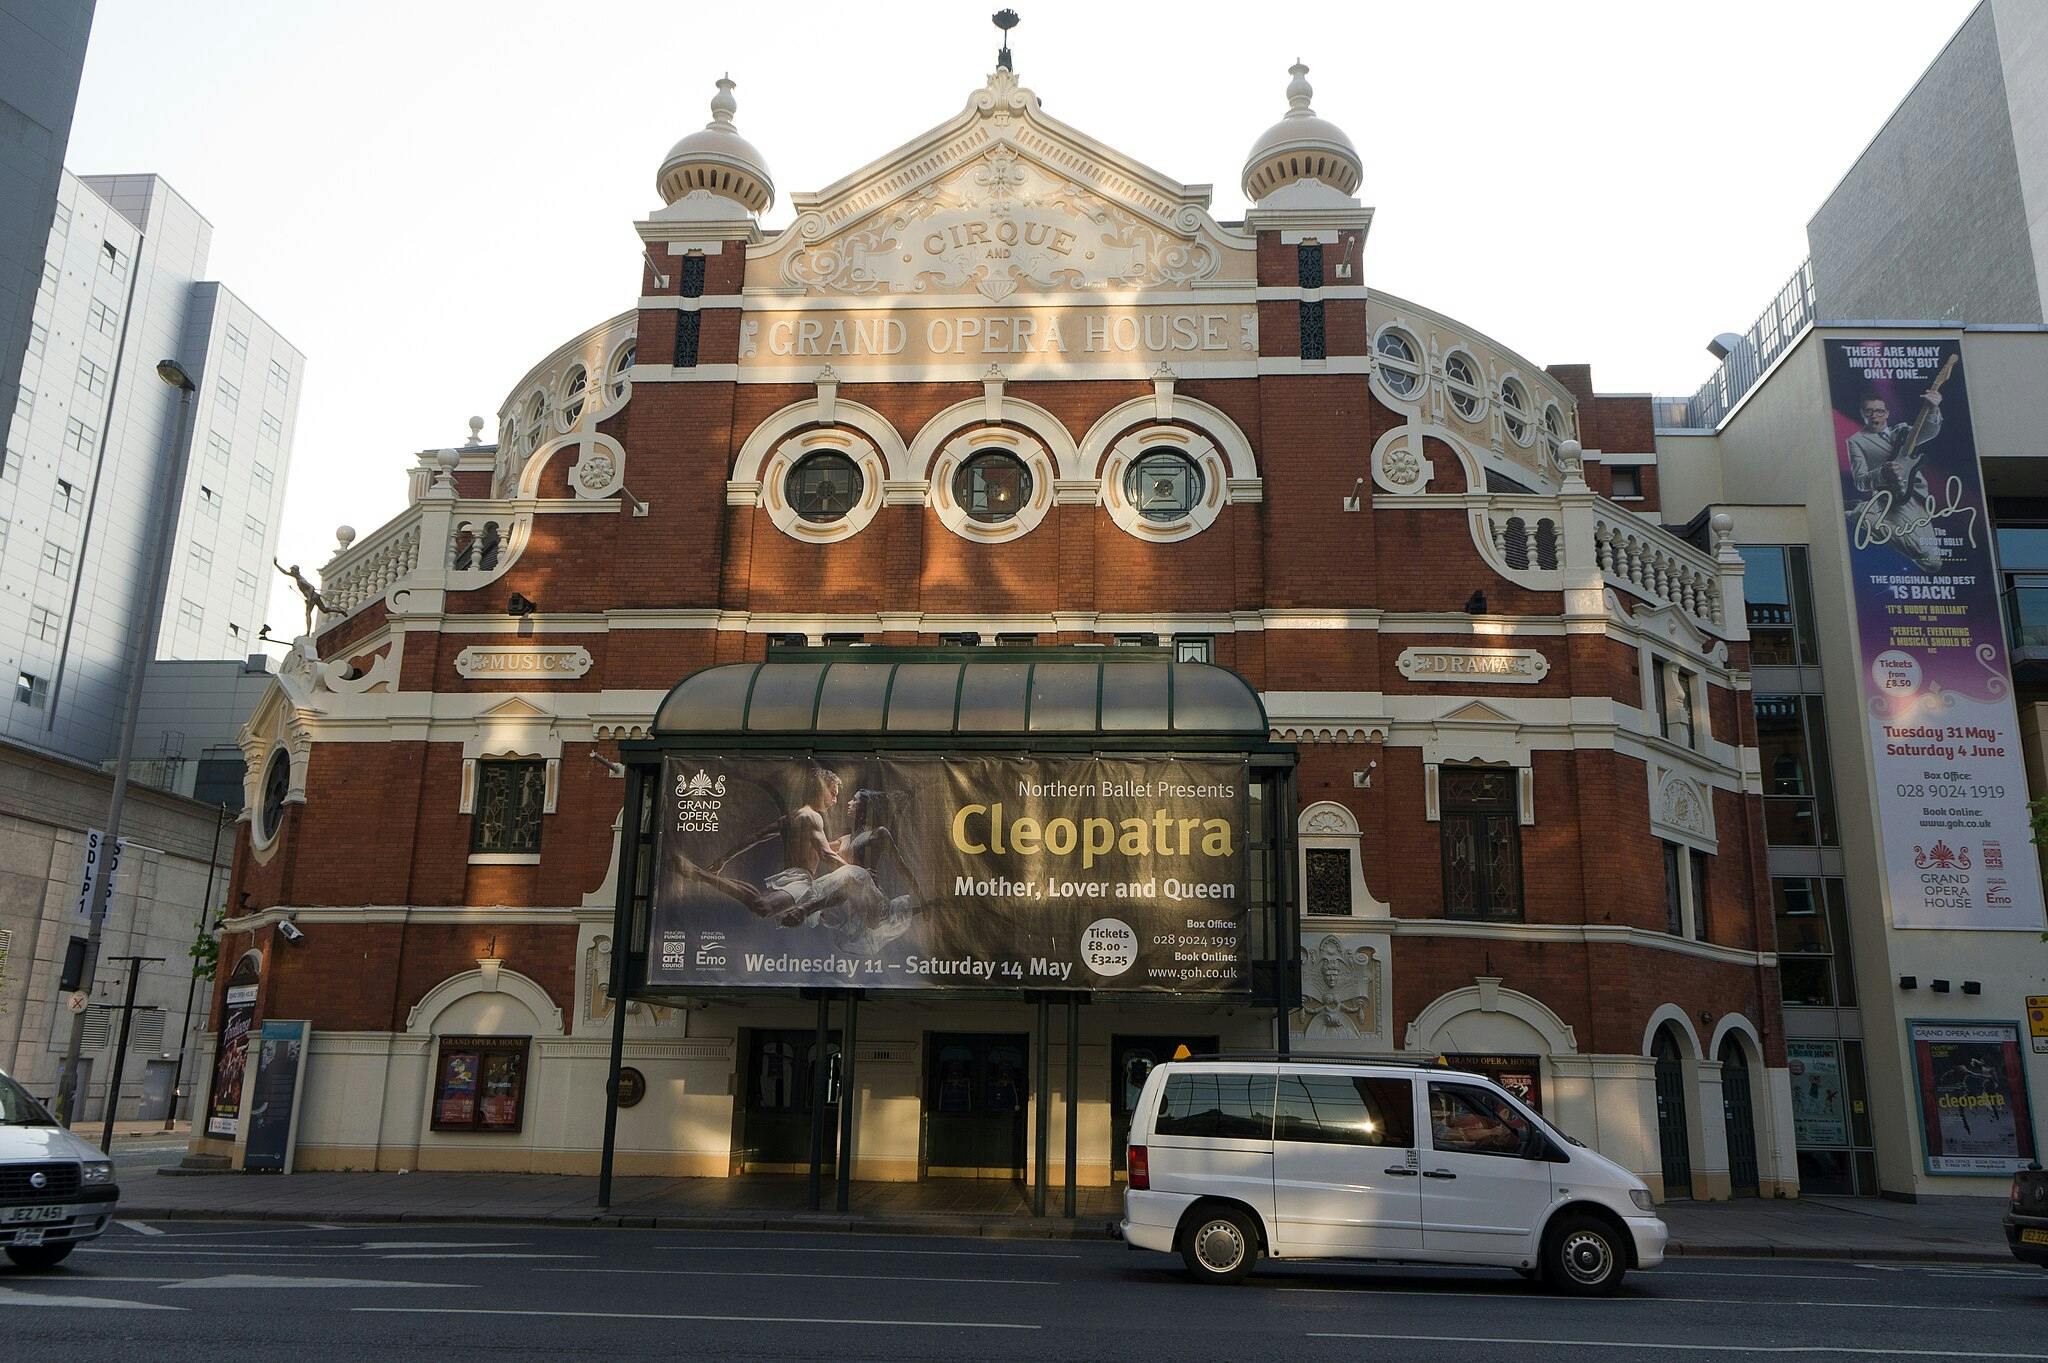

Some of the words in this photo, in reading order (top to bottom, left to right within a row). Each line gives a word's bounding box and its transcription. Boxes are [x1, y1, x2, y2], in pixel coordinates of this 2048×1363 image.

[923, 219, 1078, 256] CIRQUE
[985, 248, 1011, 259] AND
[768, 318, 907, 356] GRAND
[926, 316, 1065, 355] OPERA
[1084, 312, 1231, 353] HOUSE
[1883, 347, 1906, 357] ARE
[1906, 347, 1940, 357] MANY
[1849, 357, 1915, 369] IMITATIONS
[1916, 358, 1940, 368] BUT
[1863, 368, 1893, 379] ONLY
[1934, 527, 1947, 537] The
[1943, 538, 1964, 547] HOLLY
[1870, 575, 1888, 585] THE
[1889, 576, 1931, 585] ORIGINAL
[1932, 576, 1951, 585] AND
[1952, 576, 1976, 585] BEST
[1911, 586, 1956, 600] BACK!
[489, 654, 557, 671] MUSIC
[1433, 655, 1513, 674] DRAMA
[1879, 659, 1913, 669] Tickets
[1888, 670, 1906, 679] from
[1883, 725, 1944, 743] Tuesday
[1946, 726, 1964, 739] 31
[1966, 726, 1996, 743] May
[1886, 743, 1955, 761] Saturday
[1957, 745, 1968, 757] 4
[1970, 745, 2005, 758] June
[1923, 771, 1941, 780] Box
[1018, 780, 1096, 798] Northern
[1101, 781, 1153, 798] Ballet
[1158, 781, 1235, 799] Presents
[1896, 784, 1925, 798] 028
[1928, 785, 1967, 799] 9024
[1970, 785, 2005, 799] 1919
[677, 800, 722, 812] GRAND
[1922, 807, 1947, 817] Book
[679, 811, 719, 823] OPERA
[676, 822, 719, 832] HOUSE
[1919, 819, 1992, 830] www.goh.co.uk
[952, 802, 1234, 870] Cleopatra
[1920, 873, 1970, 886] GRAND
[954, 875, 1041, 901] Mother,
[1049, 877, 1109, 898] Lover
[1115, 877, 1156, 898] and
[1163, 878, 1236, 902] Queen
[1924, 885, 1970, 899] OPERA
[1924, 898, 1973, 909] HOUSE
[1986, 892, 2012, 905] Emo
[1186, 919, 1205, 929] Box
[1206, 919, 1237, 929] Office:
[1088, 928, 1130, 939] Tickets
[1087, 940, 1121, 952] £8.00
[1153, 933, 1175, 945] 028
[1178, 935, 1208, 948] 9024
[1211, 936, 1237, 948] 1919
[662, 954, 685, 963] arts
[695, 951, 727, 966] Emo
[1090, 954, 1128, 966] £32.25
[1174, 952, 1199, 962] Book
[1201, 952, 1237, 963] Online:
[744, 953, 860, 978] Wednesday
[864, 961, 884, 974] 11
[904, 955, 996, 980] Saturday
[1001, 961, 1024, 980] 14
[1029, 957, 1073, 981] May
[1148, 966, 1238, 980] www.goh.co.uk
[1914, 1029, 1943, 1038] GRAND
[1945, 1030, 1970, 1039] OPERA
[442, 1039, 469, 1047] GRAND
[471, 1039, 497, 1047] OPERA
[1448, 1057, 1479, 1066] GRAND
[1480, 1057, 1508, 1066] OPERA
[1510, 1057, 1538, 1066] HOUSE
[1500, 1078, 1533, 1086] THRILLER
[1938, 1092, 2006, 1110] cleopatra
[36, 1206, 63, 1219] 7451
